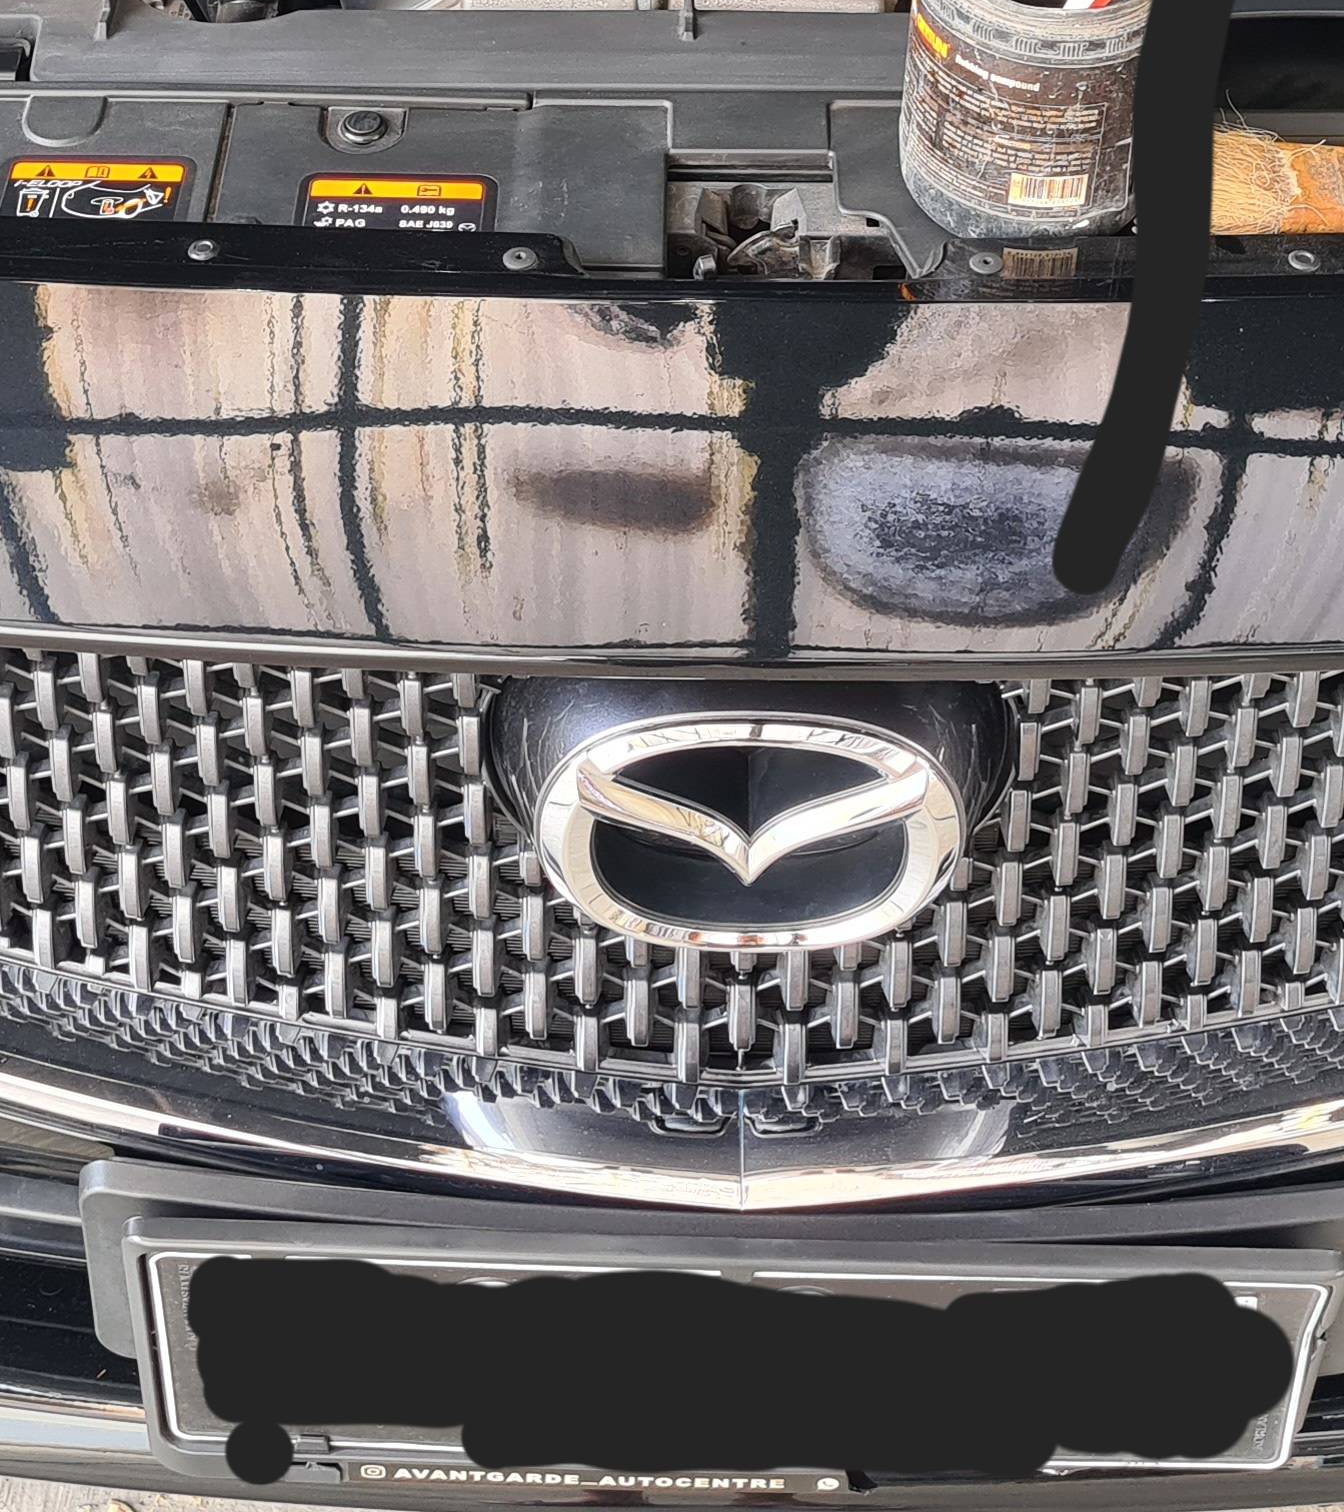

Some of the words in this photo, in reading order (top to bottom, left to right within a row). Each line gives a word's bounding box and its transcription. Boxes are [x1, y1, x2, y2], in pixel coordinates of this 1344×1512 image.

[338, 203, 383, 214] R-134a
[400, 204, 436, 214] 0.490
[438, 205, 456, 216] kg
[335, 218, 366, 228] PAG
[399, 220, 424, 228] SAE
[393, 1467, 786, 1489] AVANTGARDE_AUTOCENTRE
